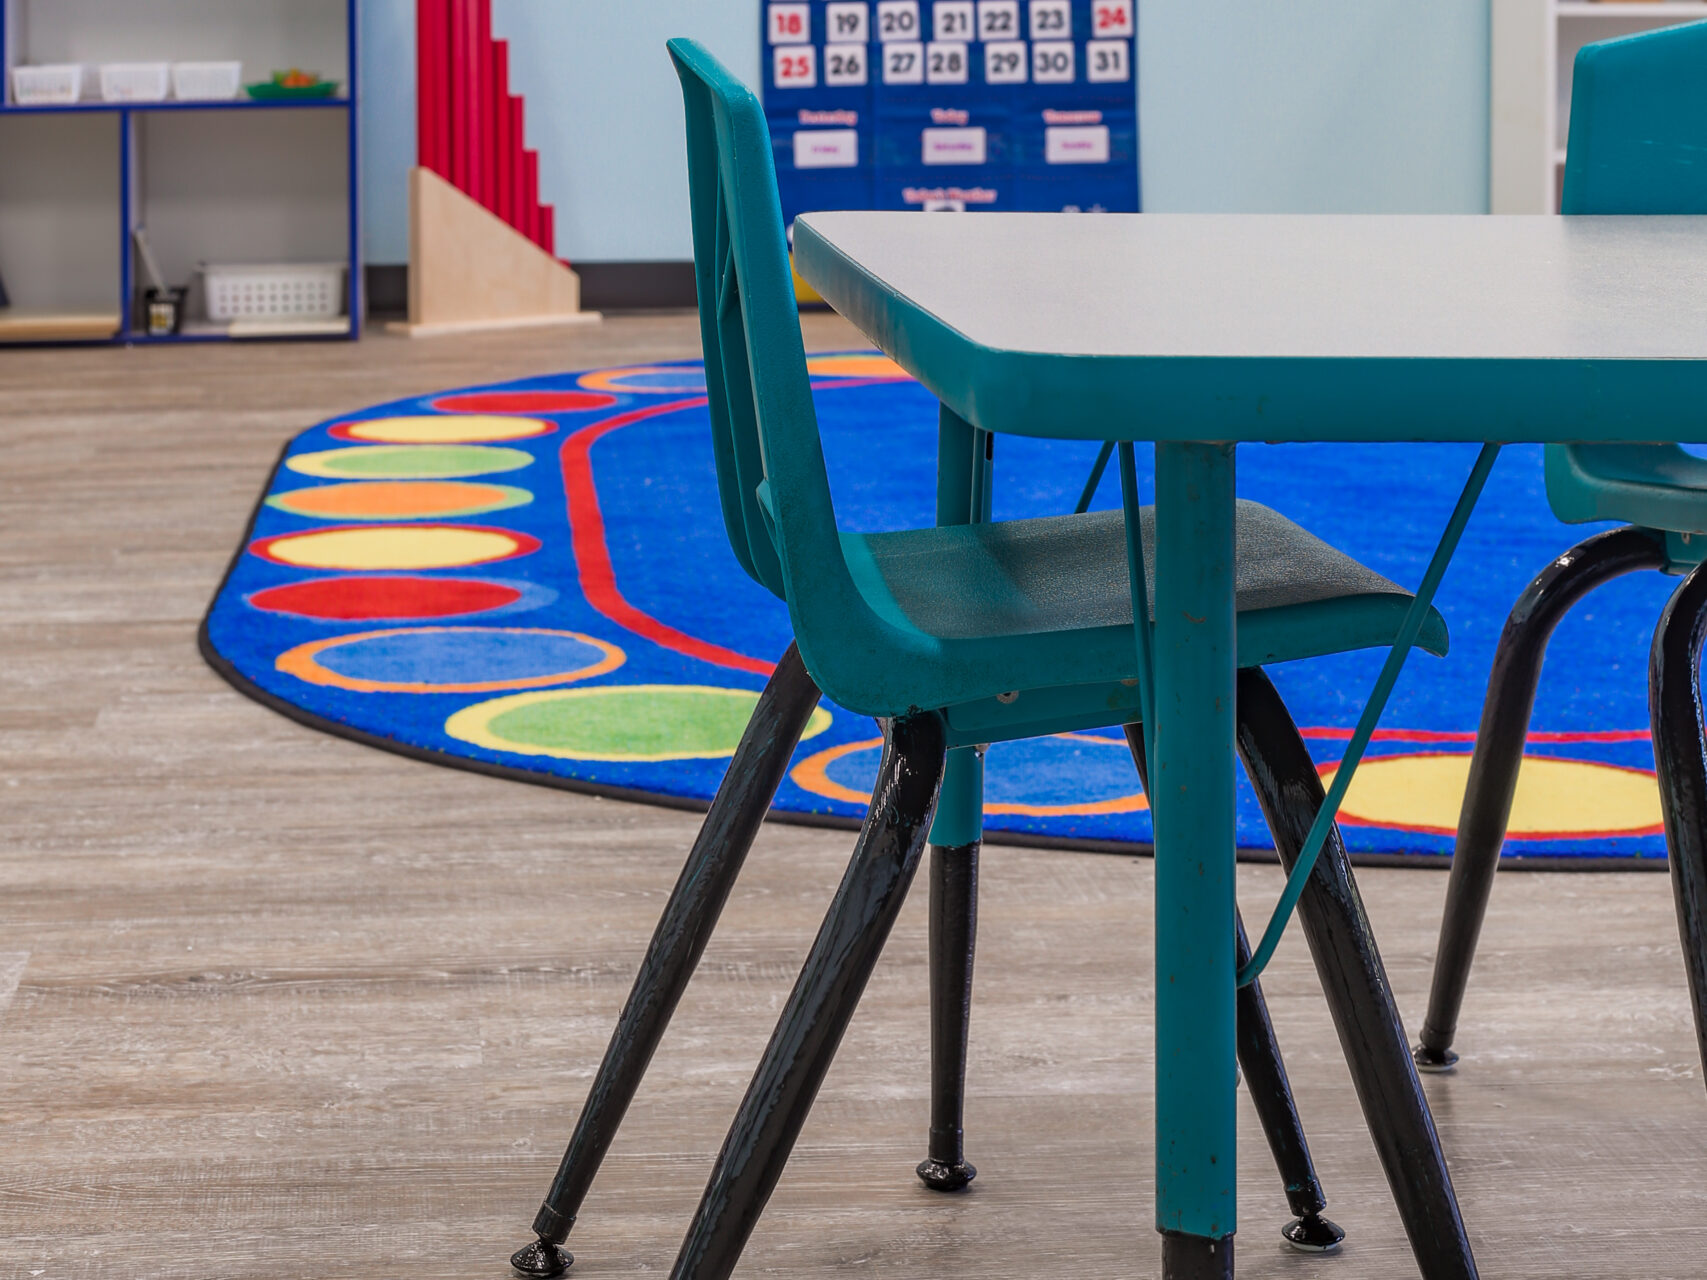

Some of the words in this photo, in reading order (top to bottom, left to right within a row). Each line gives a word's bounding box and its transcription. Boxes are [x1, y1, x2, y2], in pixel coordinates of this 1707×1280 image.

[776, 13, 802, 35] 18
[836, 13, 859, 34] 19
[883, 11, 915, 33] 20
[943, 12, 967, 34] 21
[985, 11, 1012, 33] 22
[1037, 9, 1065, 31] 23
[1098, 7, 1126, 29] 24
[781, 56, 809, 78] 25
[831, 55, 860, 76] 26
[891, 52, 916, 74] 27
[932, 52, 962, 73] 28
[992, 52, 1020, 74] 29
[1036, 51, 1070, 74] 30
[1095, 50, 1121, 72] 31
